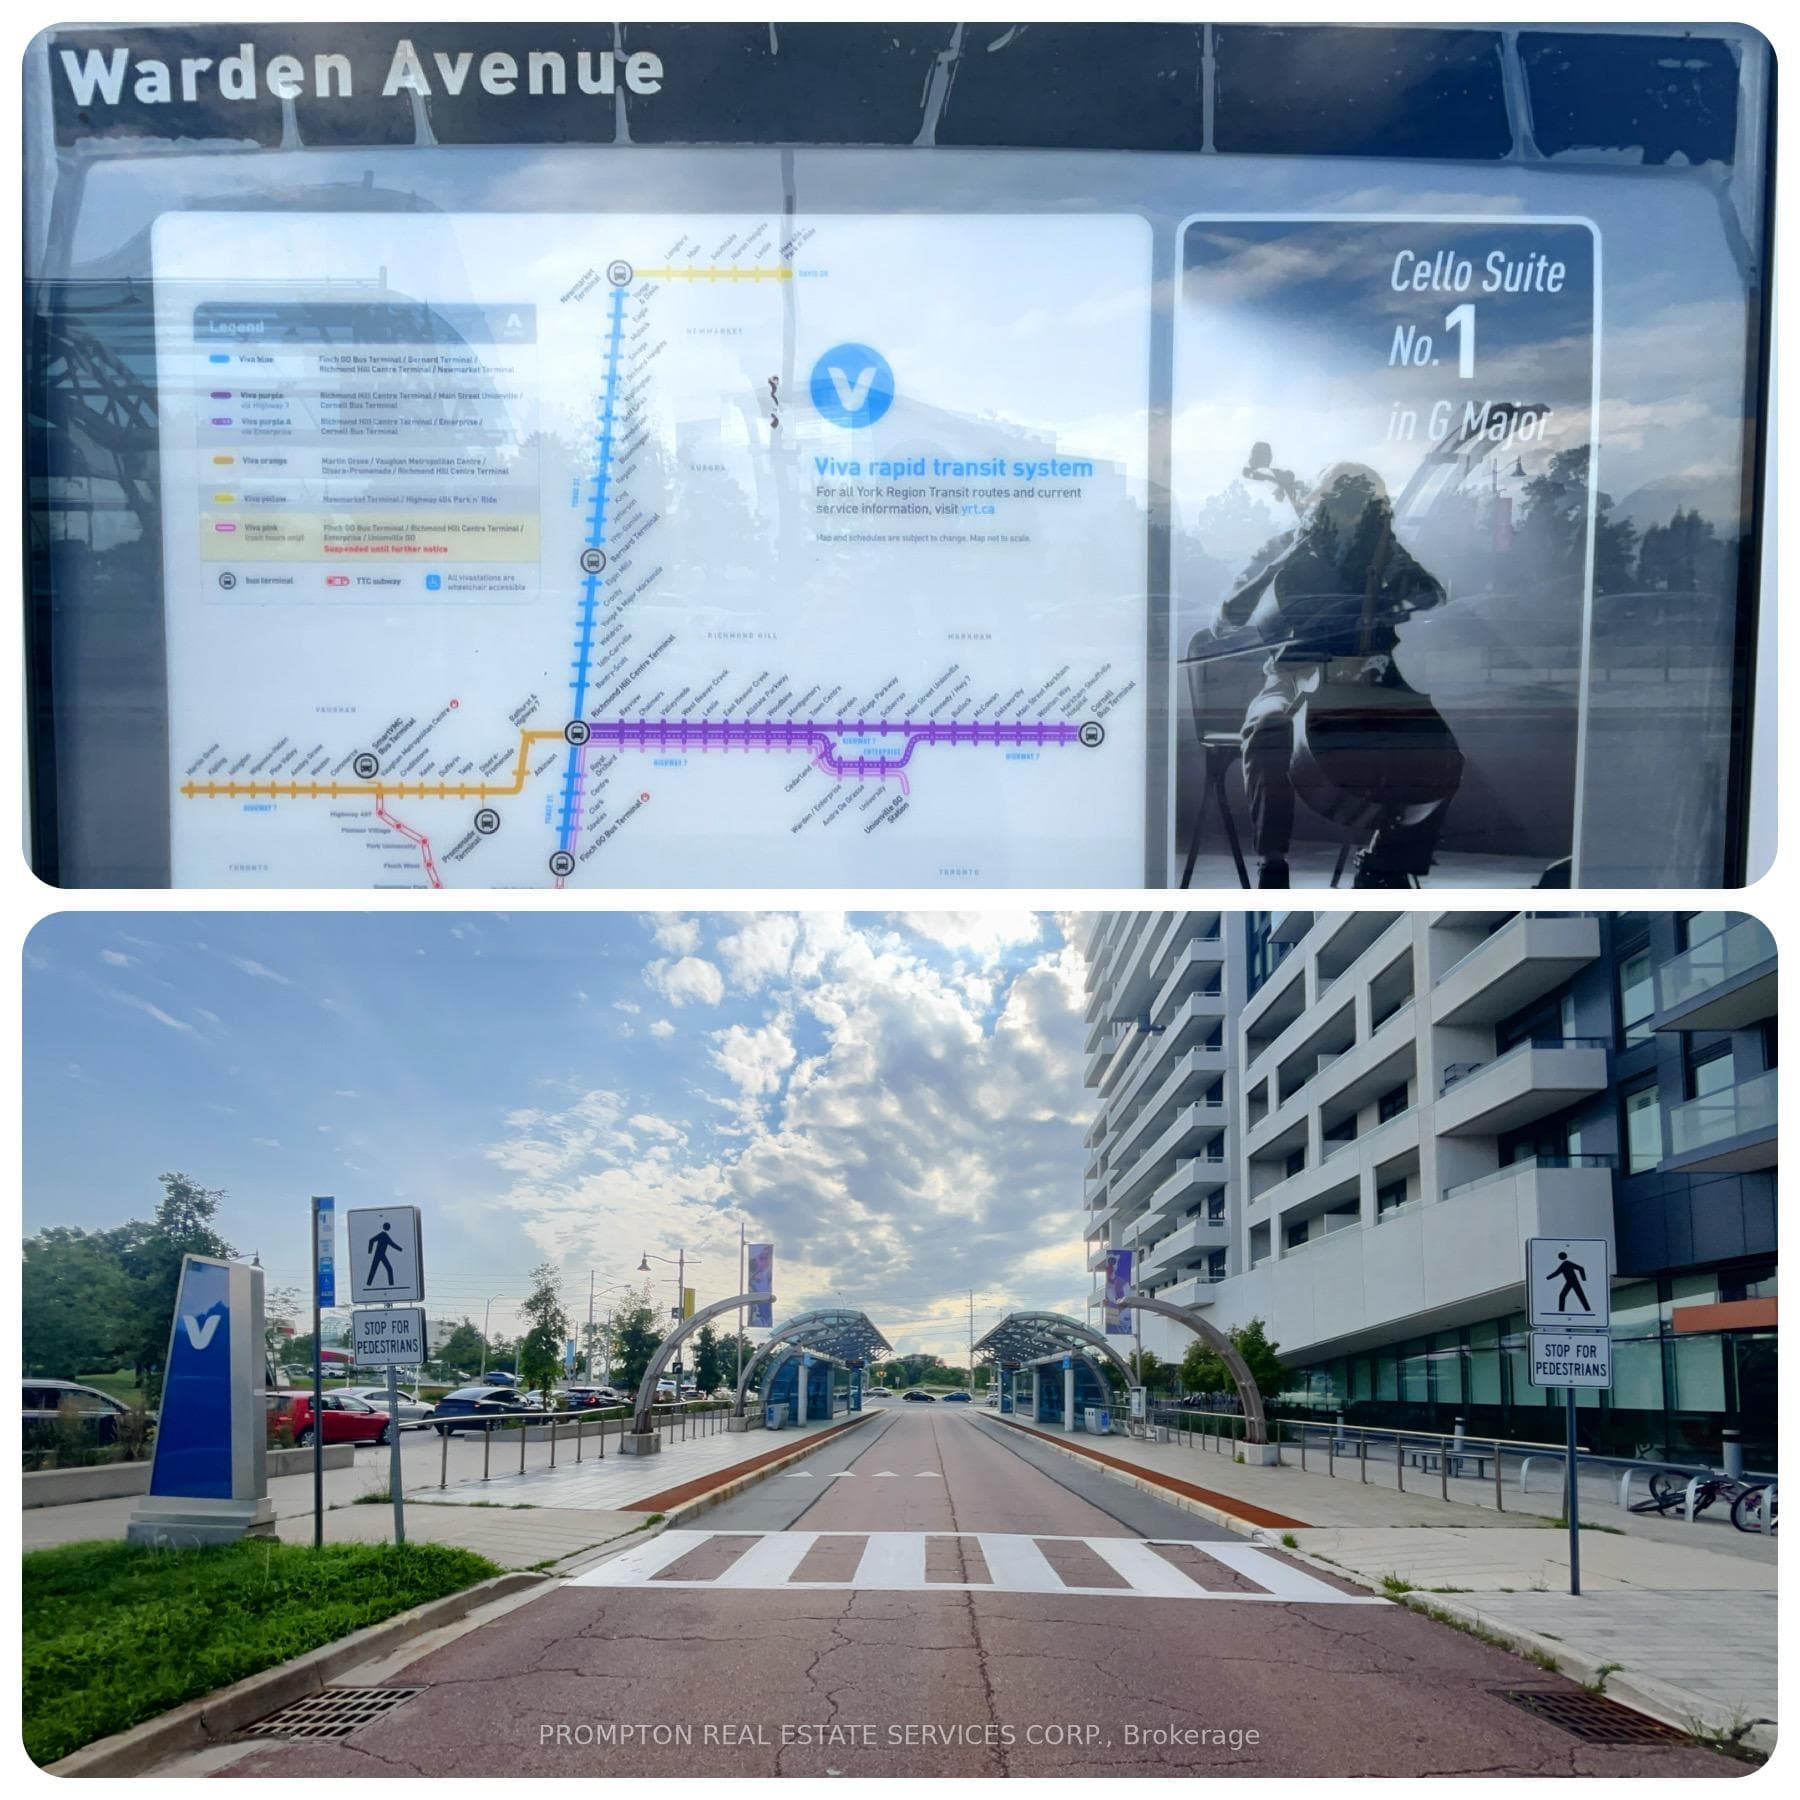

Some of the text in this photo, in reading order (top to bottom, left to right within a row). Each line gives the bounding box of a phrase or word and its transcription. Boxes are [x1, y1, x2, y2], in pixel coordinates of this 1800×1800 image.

[60, 38, 666, 106] Warden Avenue
[1391, 250, 1567, 293] Cello Suite
[209, 320, 264, 336] Legend
[1388, 304, 1475, 378] No. 1
[827, 367, 877, 412] V
[1387, 400, 1554, 451] in G Major
[815, 457, 1093, 481] Viva rapid transit system
[816, 487, 1082, 501] For all York Region Transit routes and current
[816, 503, 995, 516] service information, visit yrt.ca
[324, 546, 448, 554] Suspended until further notice
[357, 577, 402, 585] TTC subway
[591, 633, 677, 718] Richmond Hill Centre Terminal
[1108, 680, 1136, 706] Terminal
[379, 717, 417, 756] Bus Terminal
[864, 803, 895, 834] Unionville
[887, 801, 910, 824] Station
[579, 847, 595, 863] Finch
[604, 823, 617, 837] Bus
[614, 799, 642, 826] Terminal
[441, 830, 476, 864] Promenade
[455, 836, 482, 863] Terminal
[183, 1315, 221, 1350] V
[364, 1320, 409, 1336] STOP FOR
[357, 1338, 418, 1355] PEDESTRIANS
[1545, 1344, 1597, 1358] STOP FOR
[1536, 1361, 1607, 1377] PEDESTRIANS
